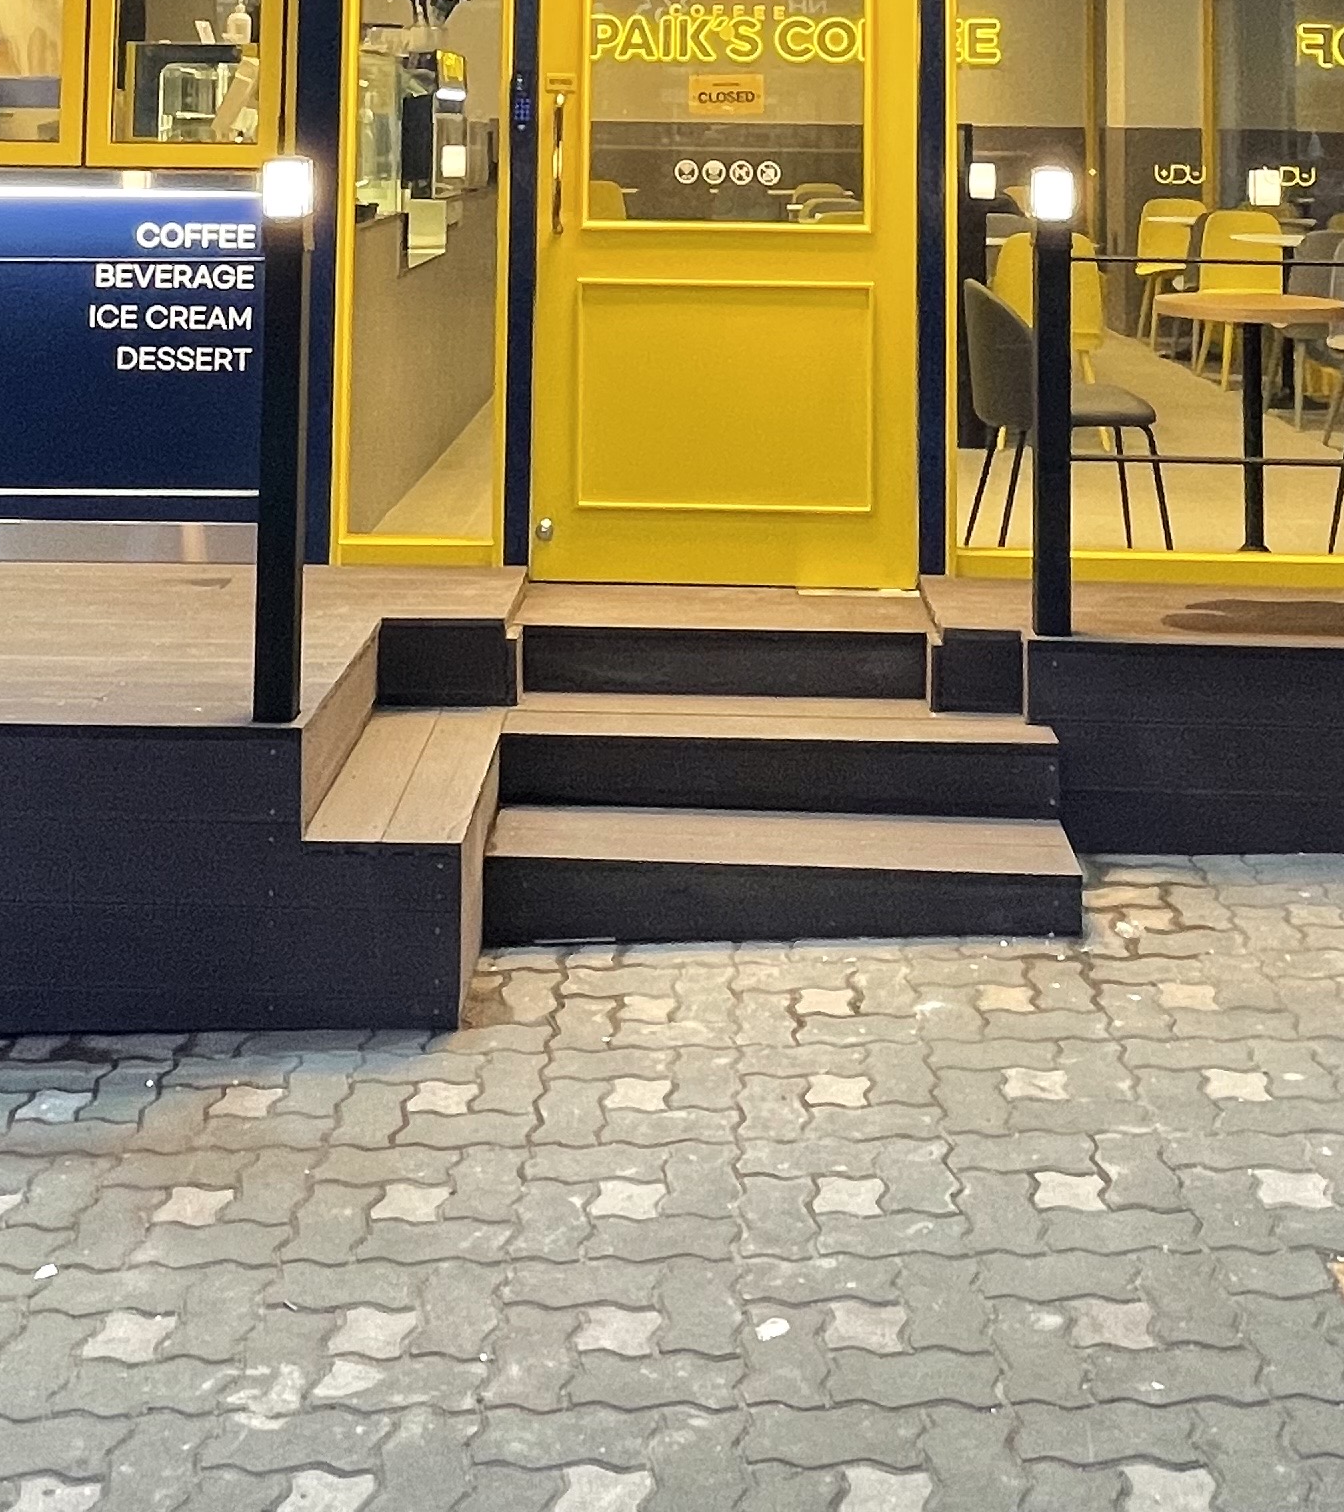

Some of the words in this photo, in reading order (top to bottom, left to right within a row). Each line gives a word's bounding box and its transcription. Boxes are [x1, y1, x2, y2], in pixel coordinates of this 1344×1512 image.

[668, 2, 787, 21] COFFEE
[590, 13, 763, 64] PAIK'S
[697, 90, 756, 104] CLOSED
[135, 221, 257, 250] COFFEE
[94, 263, 256, 291] BEVERAGE
[88, 304, 139, 330] ICE
[145, 304, 254, 332] CREAM
[116, 345, 254, 373] DESSERT
